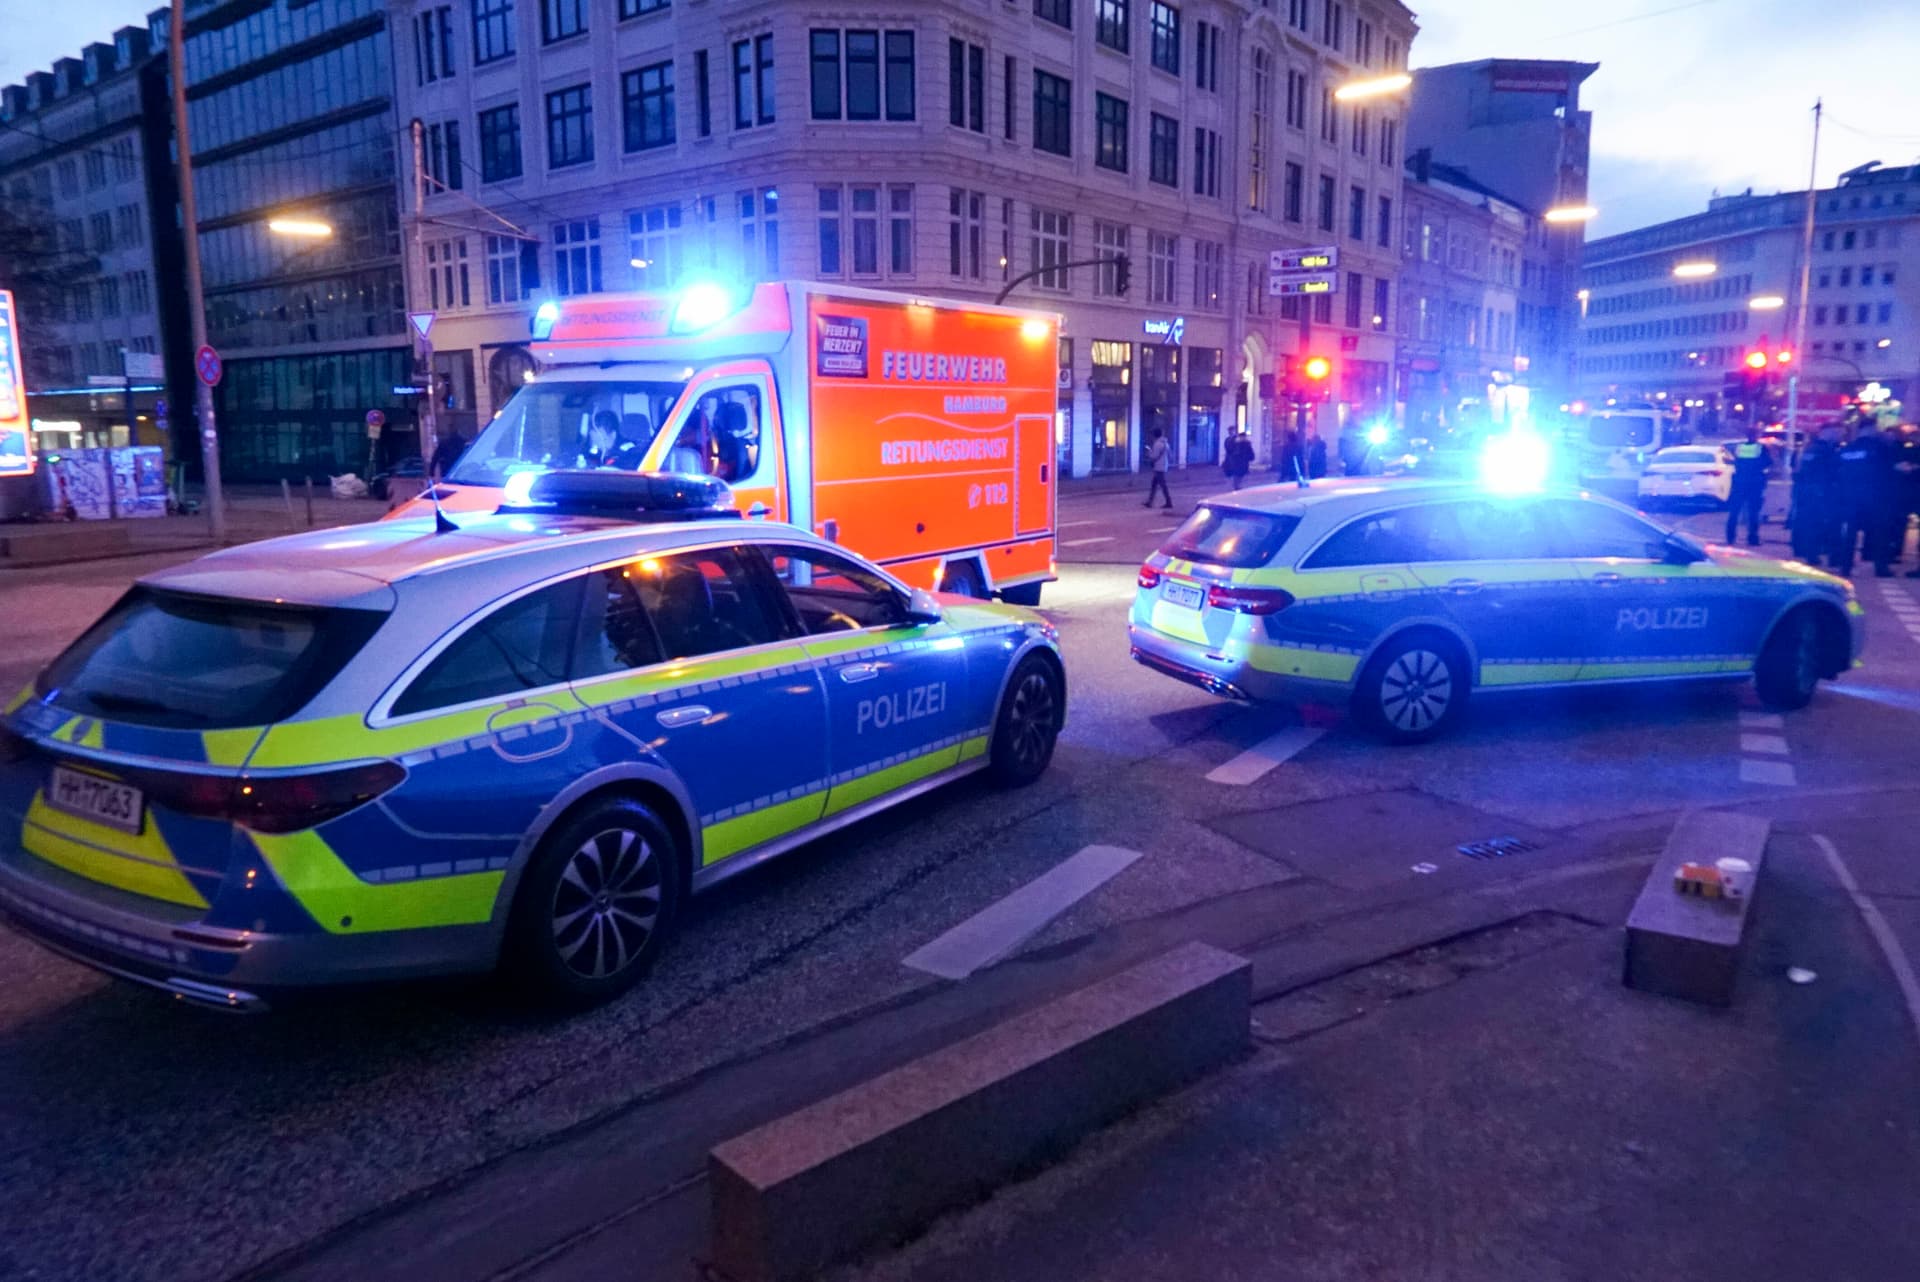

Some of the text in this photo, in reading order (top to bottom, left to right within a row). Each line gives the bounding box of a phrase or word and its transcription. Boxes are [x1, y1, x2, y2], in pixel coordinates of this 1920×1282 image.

[883, 351, 1006, 382] FEUERWEHR
[944, 395, 1006, 414] HAMBURG
[881, 438, 1008, 464] RETTUNGSDIENST
[985, 483, 1008, 505] 112
[1615, 606, 1709, 632] POLIZEI
[857, 681, 947, 735] POLIZEI
